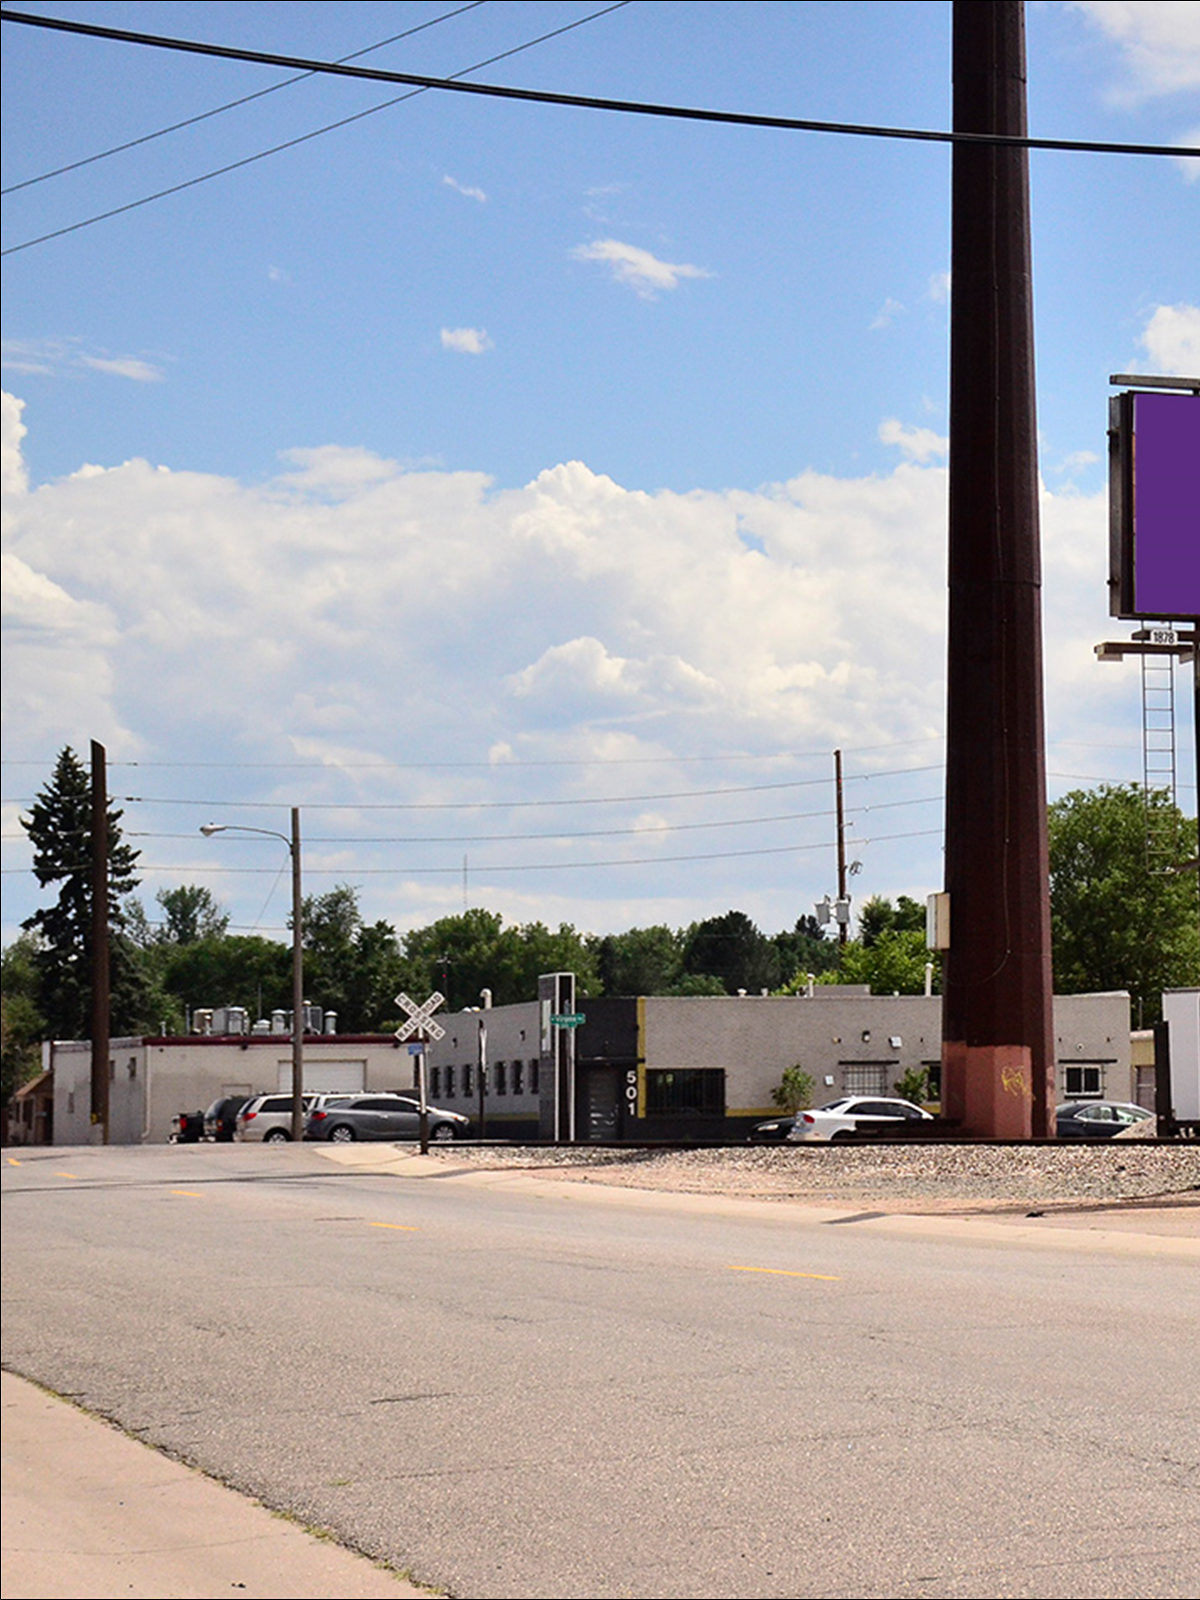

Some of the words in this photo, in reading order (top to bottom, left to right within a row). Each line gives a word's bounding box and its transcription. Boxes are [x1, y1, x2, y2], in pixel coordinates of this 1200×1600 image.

[1153, 631, 1175, 643] 1878
[397, 995, 443, 1038] CROSSING
[626, 1070, 637, 1116] 501
